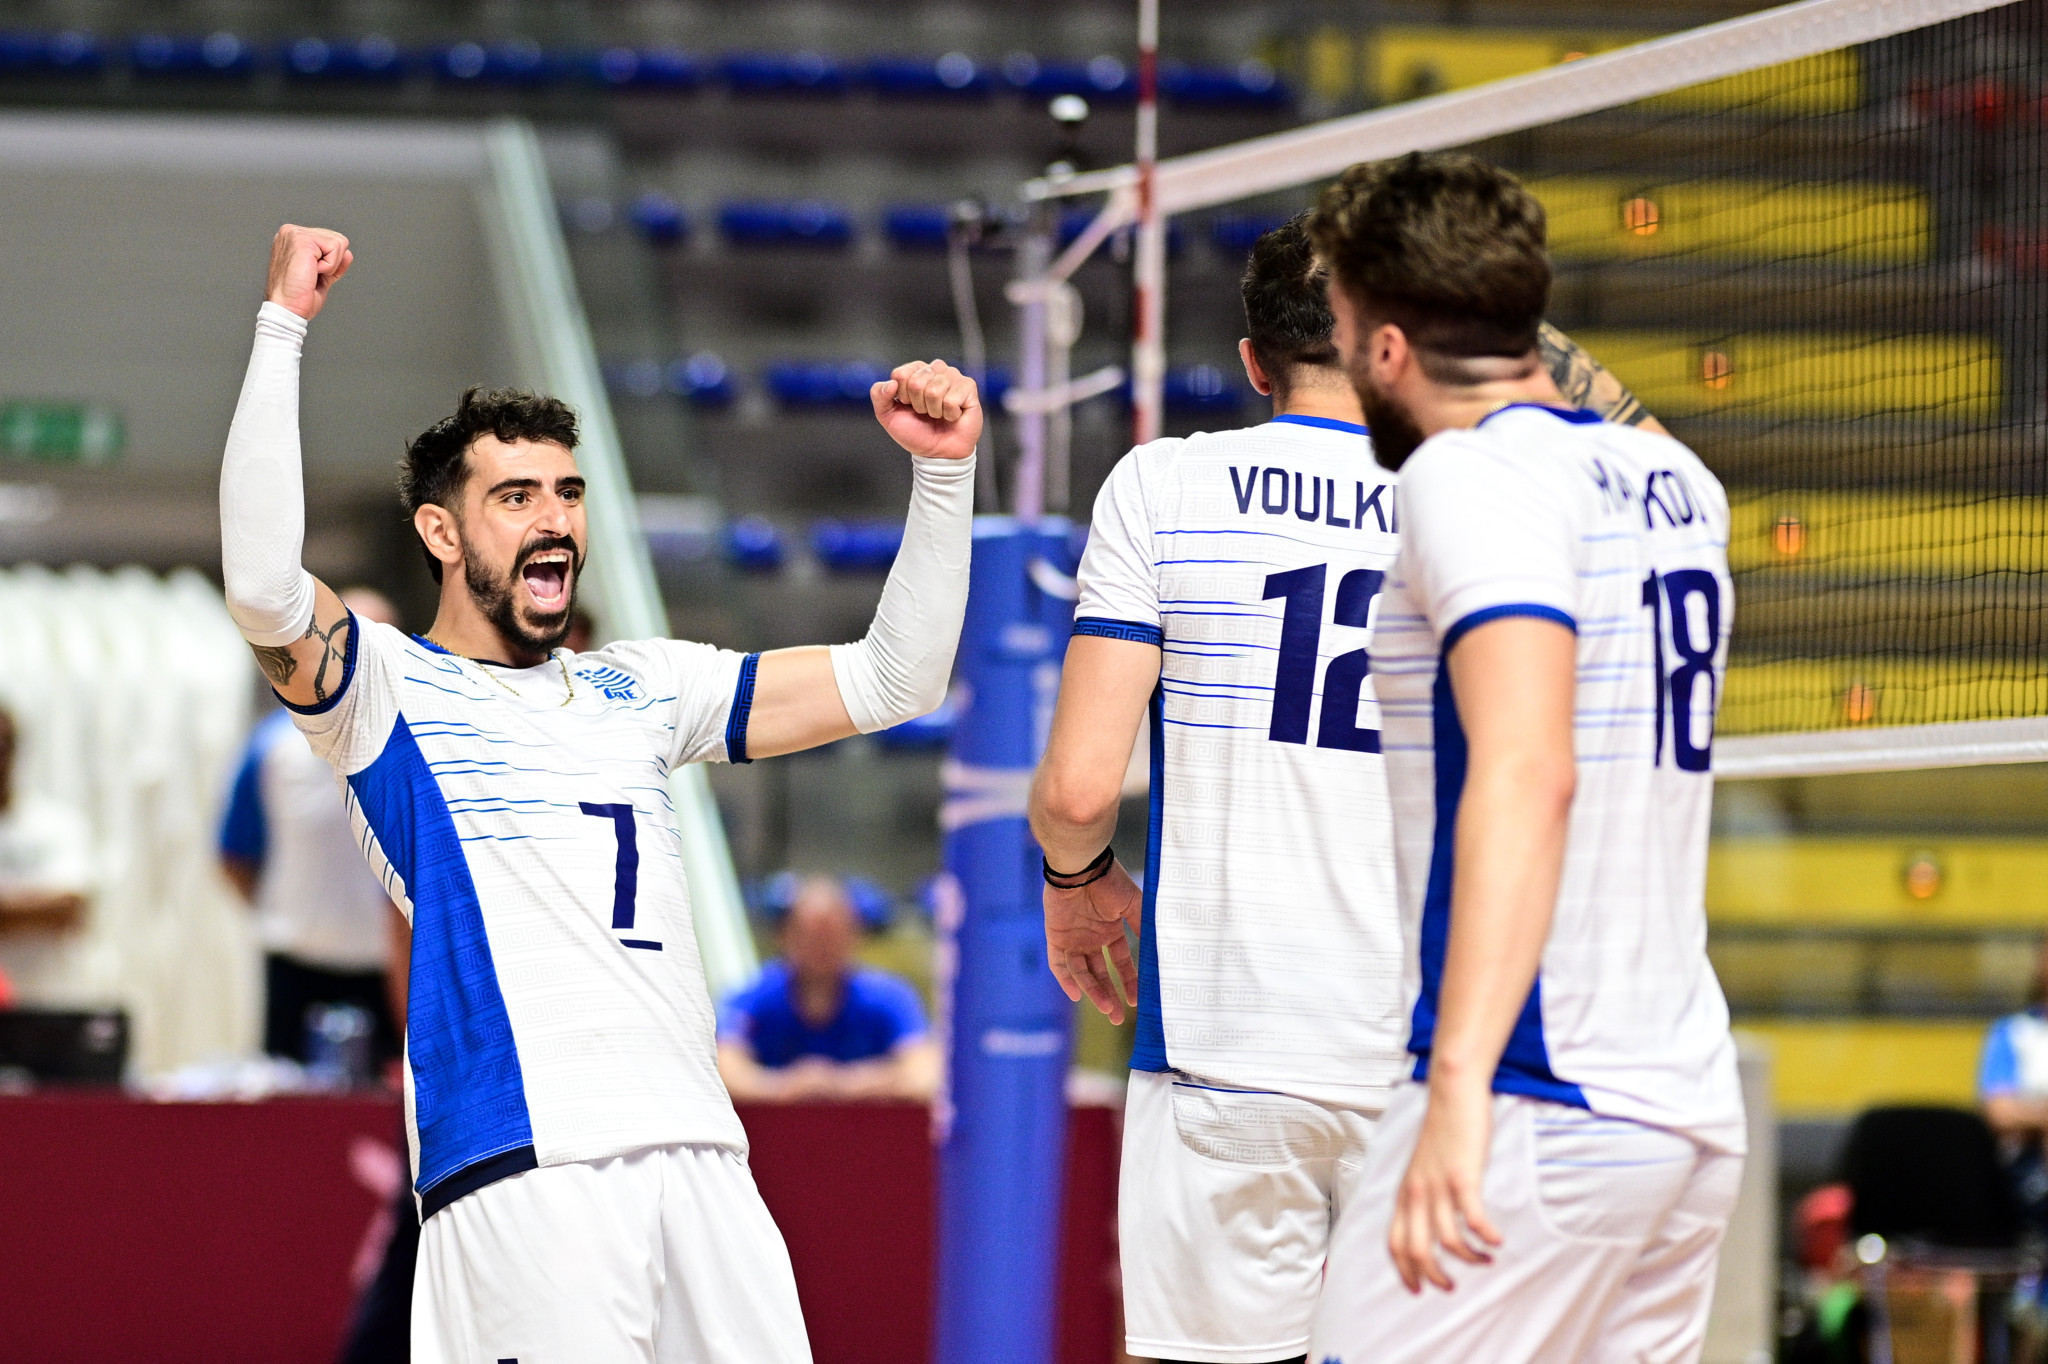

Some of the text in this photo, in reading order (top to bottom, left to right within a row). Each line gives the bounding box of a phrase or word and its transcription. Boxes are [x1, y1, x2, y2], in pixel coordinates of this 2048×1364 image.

[1262, 562, 1386, 754] 12
[1642, 568, 1719, 772] 18
[578, 801, 639, 929] 7
